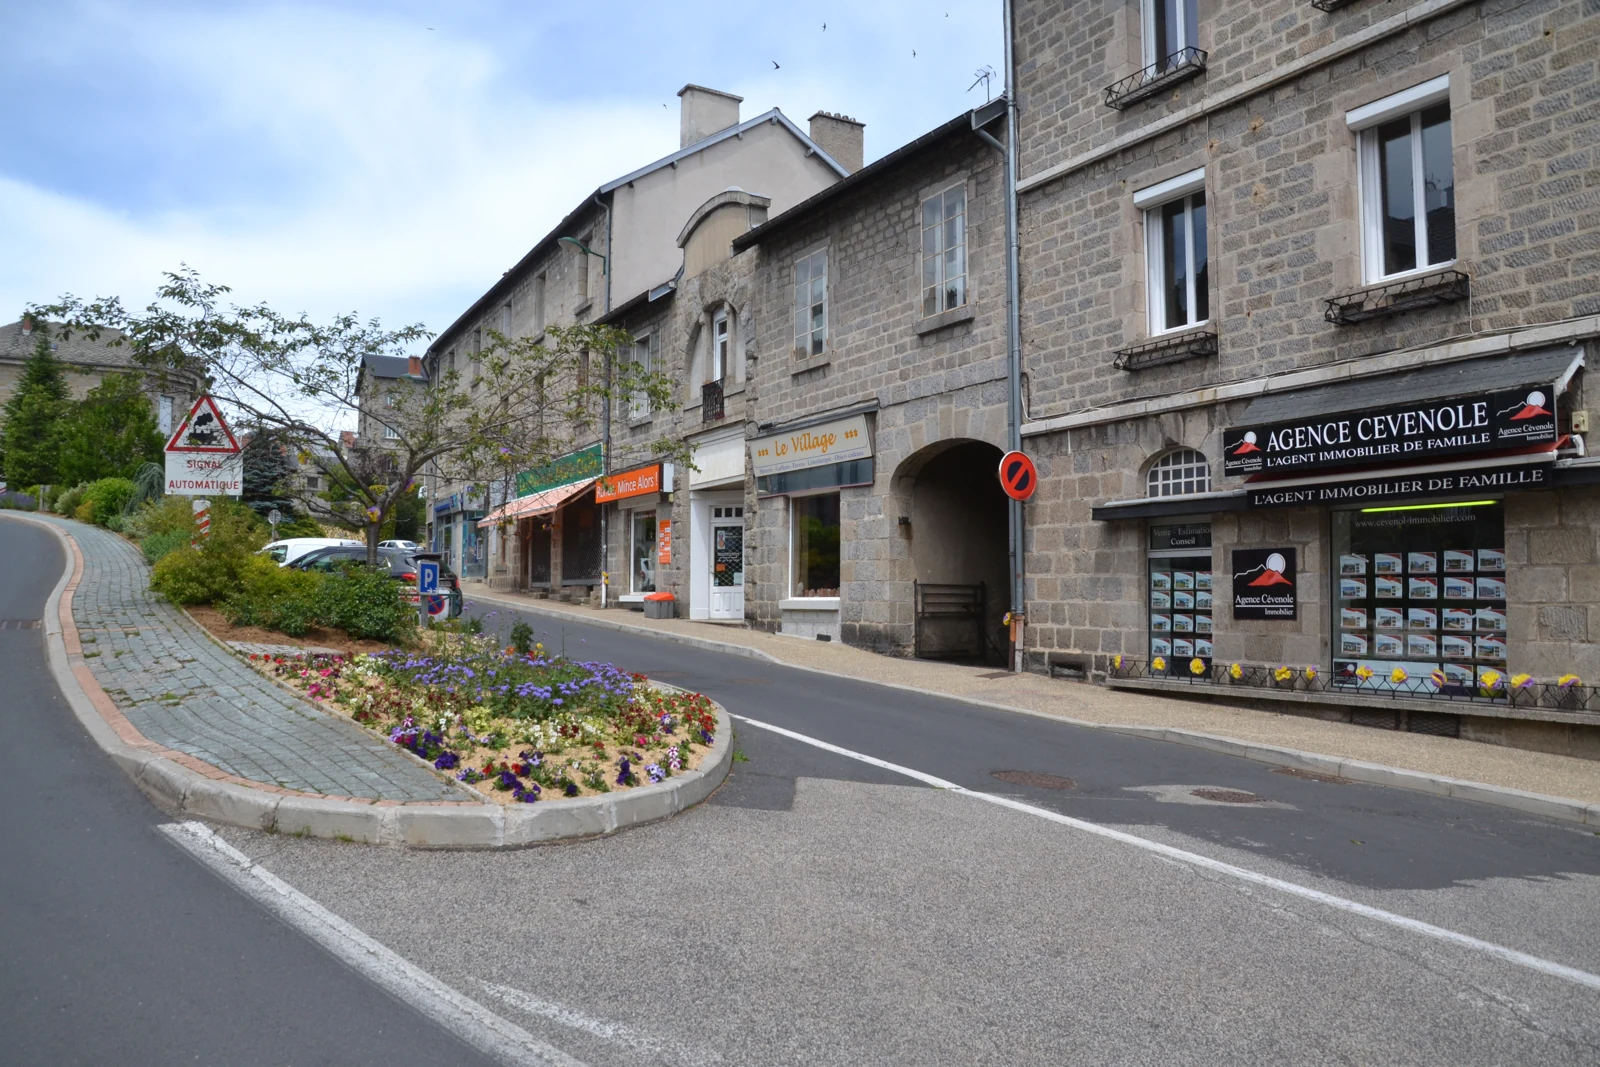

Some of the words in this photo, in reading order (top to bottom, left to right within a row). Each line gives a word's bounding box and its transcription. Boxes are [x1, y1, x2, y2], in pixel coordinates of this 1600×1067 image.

[1267, 420, 1351, 452] AGENCE
[1357, 402, 1489, 441] CEVENOLE
[1498, 427, 1522, 435] Agence
[1523, 422, 1554, 431] Cévenole
[775, 440, 788, 456] Le
[791, 431, 837, 453] Village
[1527, 433, 1555, 441] Immobilier
[1267, 453, 1316, 467] L'AGENT
[1319, 443, 1400, 461] IMMOBILIER
[1403, 439, 1423, 452] DE
[1427, 433, 1490, 450] FAMILLE
[186, 459, 223, 469] SIGNAL
[168, 480, 239, 490] AUTOMATIQUE
[617, 480, 636, 493] Mince
[637, 475, 654, 489] Alors
[1254, 490, 1315, 505] L'AGENT
[1319, 480, 1423, 500] IMMOBILIER
[1427, 477, 1455, 490] DE
[1459, 469, 1543, 487] FAMILLE
[1152, 528, 1171, 536] Vente
[1170, 537, 1195, 545] Conseil
[424, 568, 433, 588] P
[1235, 596, 1260, 605] Agence
[1261, 594, 1294, 603] Cévenole
